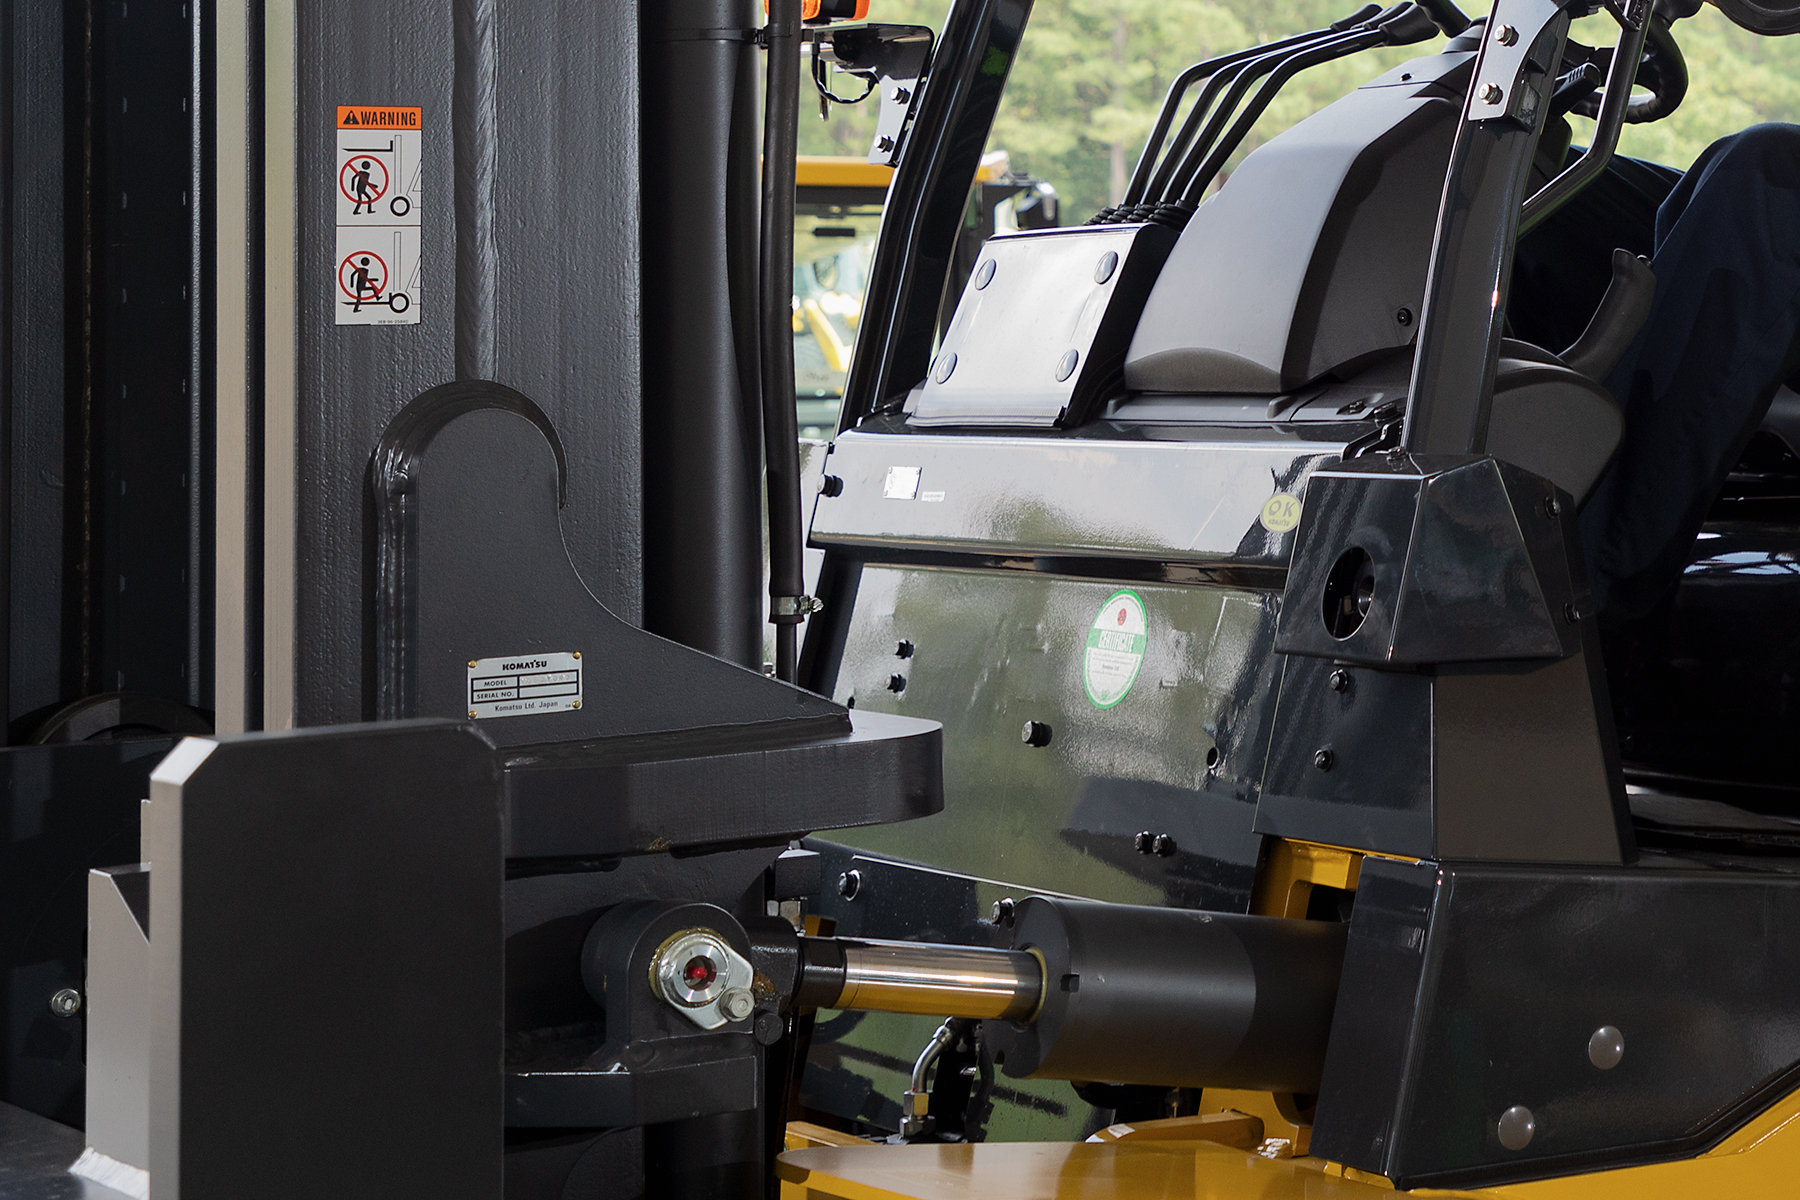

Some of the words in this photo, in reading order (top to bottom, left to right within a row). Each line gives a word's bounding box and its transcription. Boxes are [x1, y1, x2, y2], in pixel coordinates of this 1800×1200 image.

[360, 111, 417, 126] WARNING
[502, 660, 548, 671] KOMATSU
[495, 704, 523, 712] Komatsu
[539, 701, 559, 709] Japan
